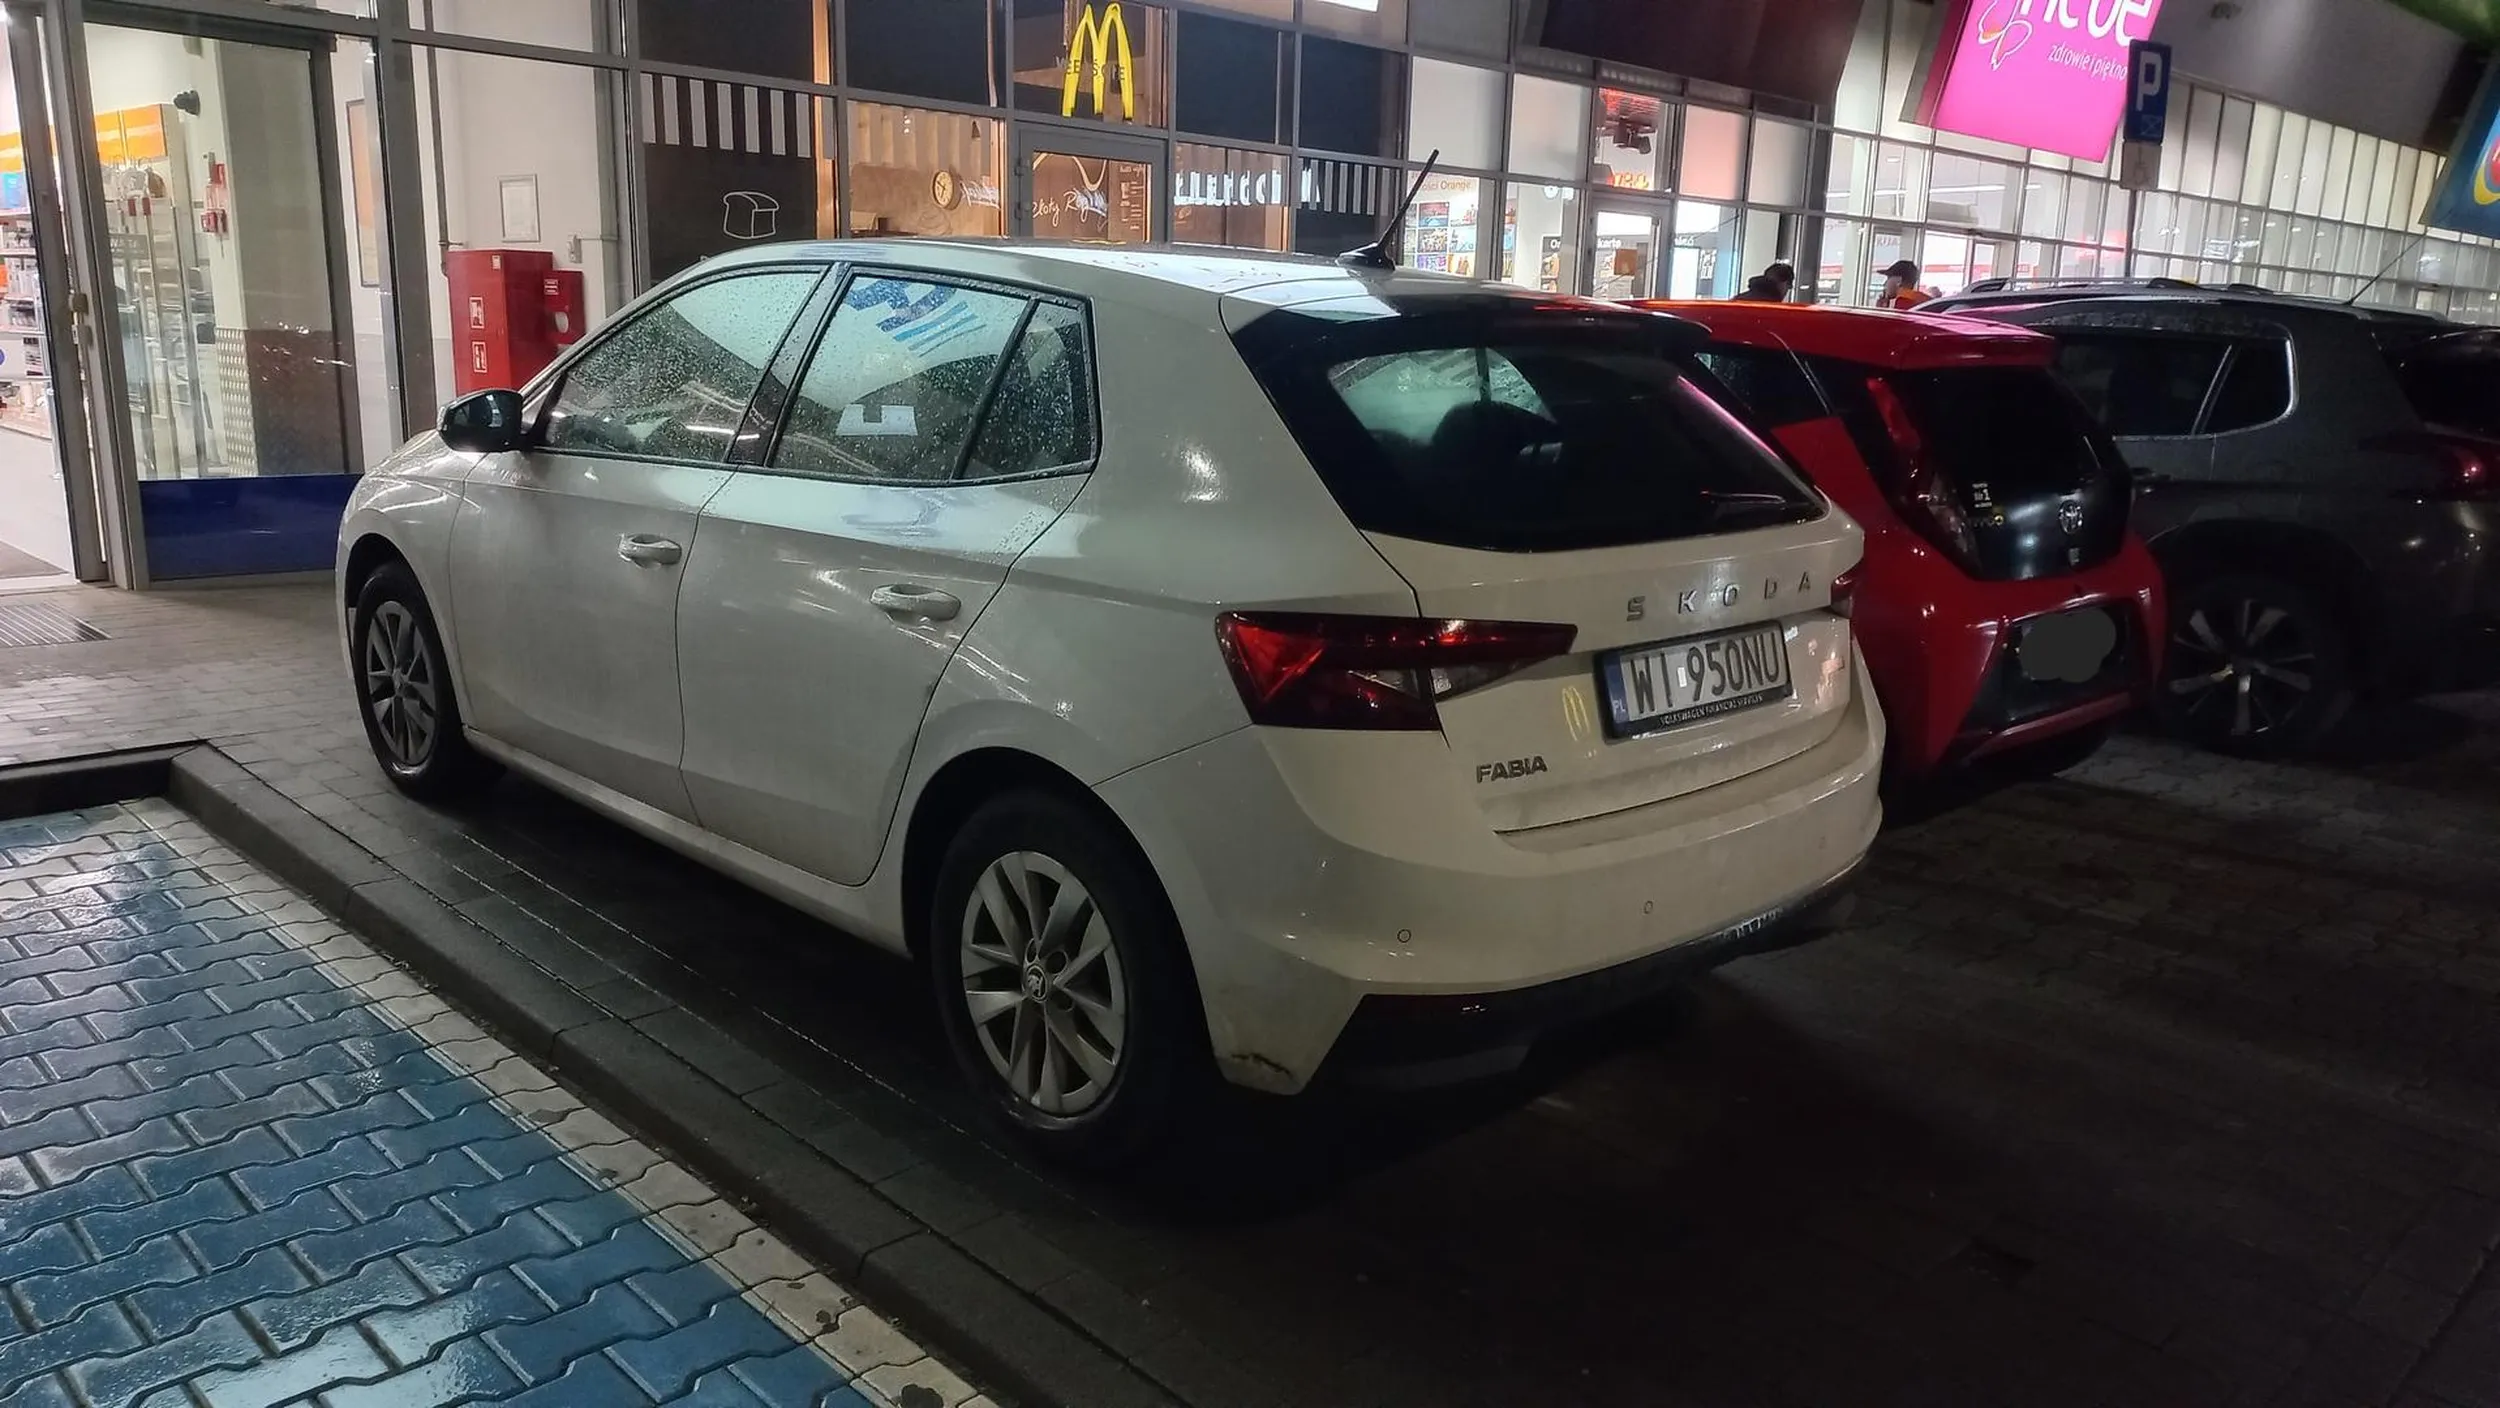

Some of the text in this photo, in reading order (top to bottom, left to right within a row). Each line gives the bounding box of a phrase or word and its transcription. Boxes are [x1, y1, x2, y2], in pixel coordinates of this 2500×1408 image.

[2048, 41, 2090, 70] zdrowie
[2091, 57, 2128, 81] piękno
[2136, 51, 2163, 112] P
[1630, 632, 1780, 714] WI 950NU
[1612, 700, 1627, 715] PL
[1660, 708, 1705, 727] VOLKSWAGEN
[1476, 755, 1548, 783] FABIA
